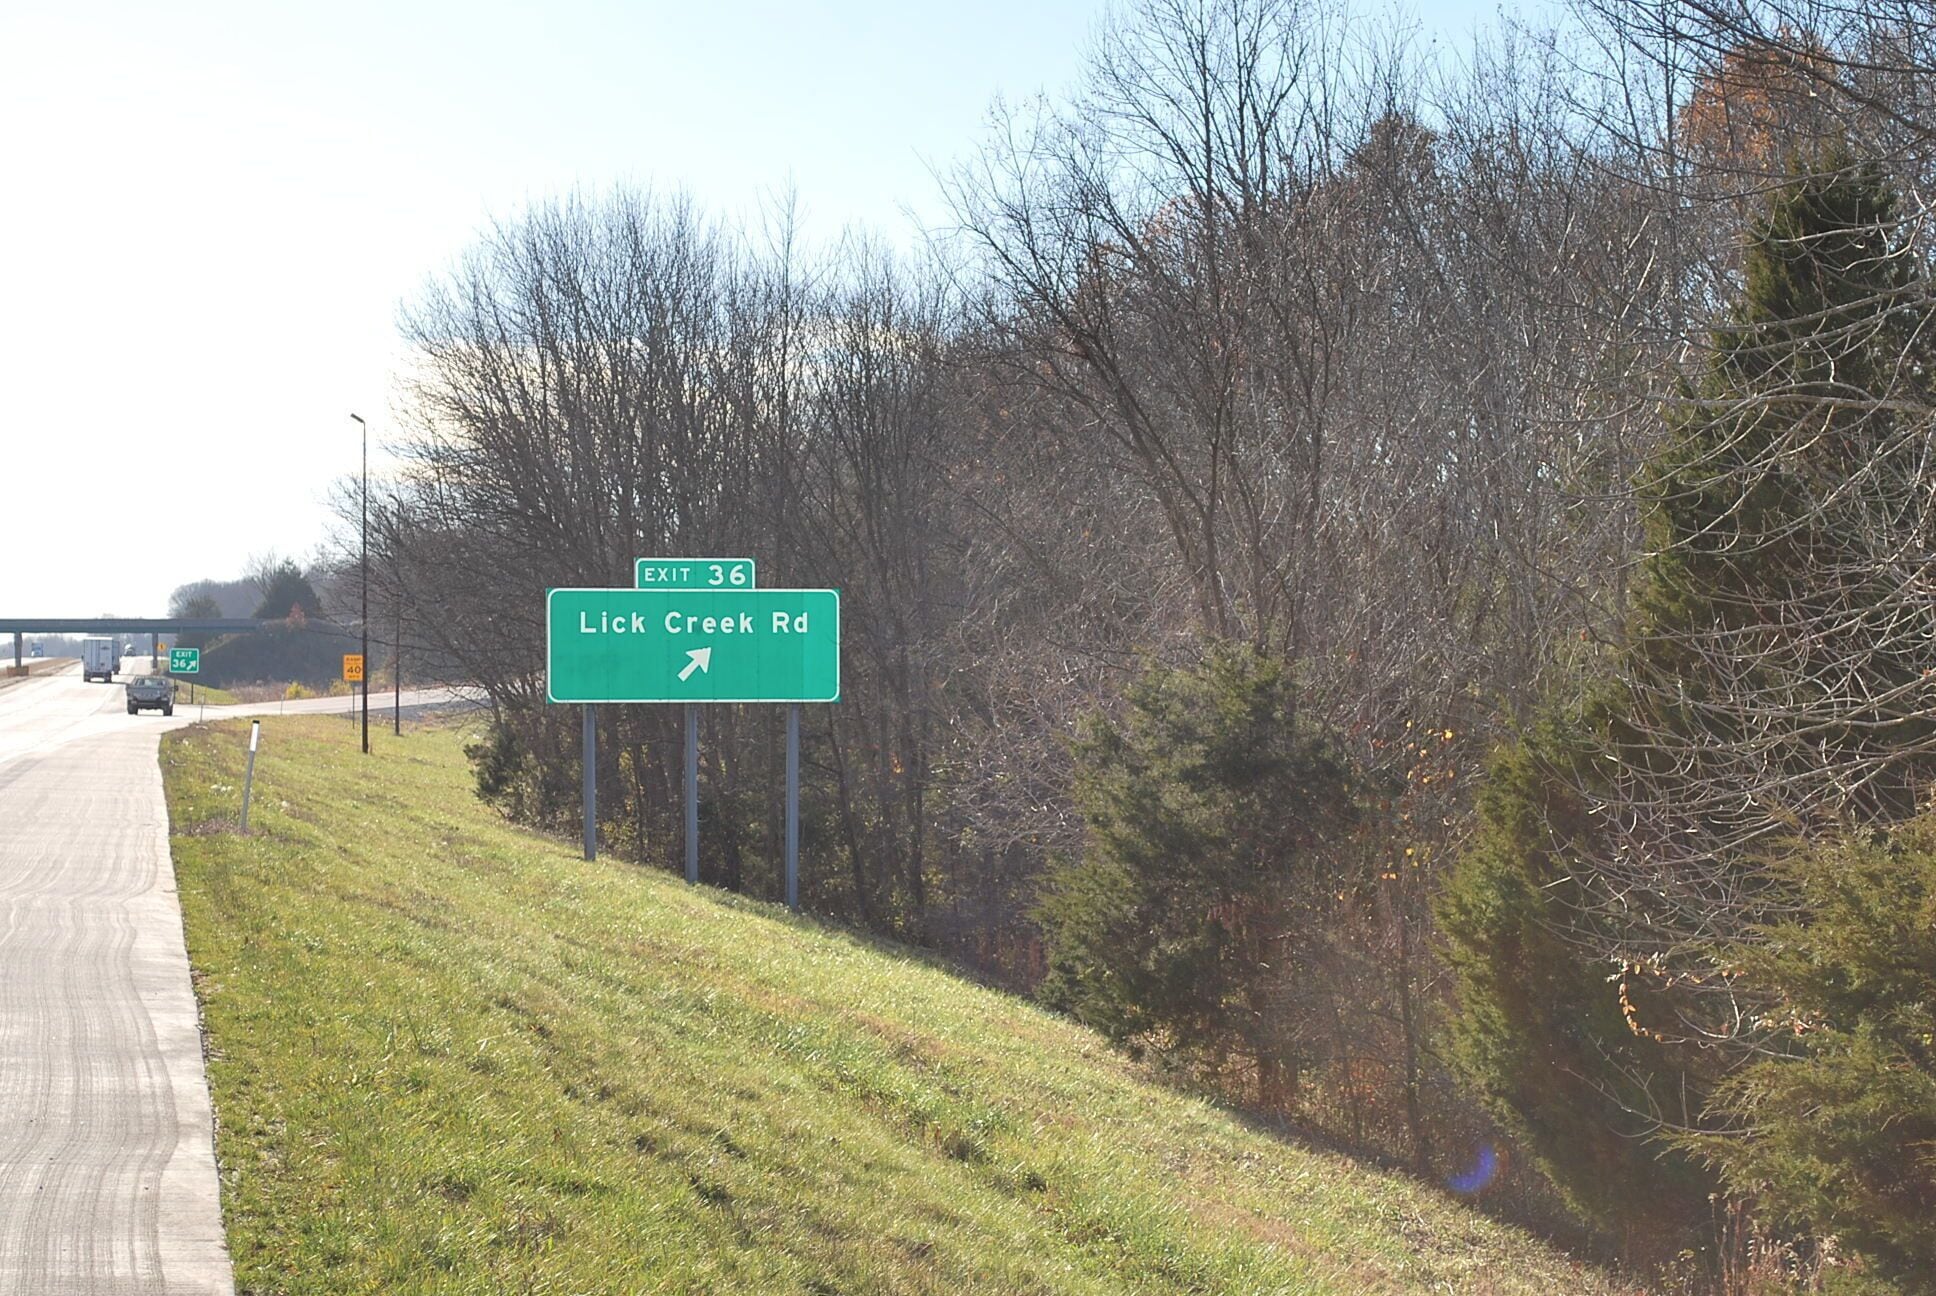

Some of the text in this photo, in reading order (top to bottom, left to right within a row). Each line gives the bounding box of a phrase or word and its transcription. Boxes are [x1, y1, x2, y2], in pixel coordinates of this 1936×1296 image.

[644, 564, 746, 586] EXIT 36
[580, 611, 808, 633] Lick Creek Rd
[172, 659, 186, 668] 36
[346, 665, 361, 674] 40
